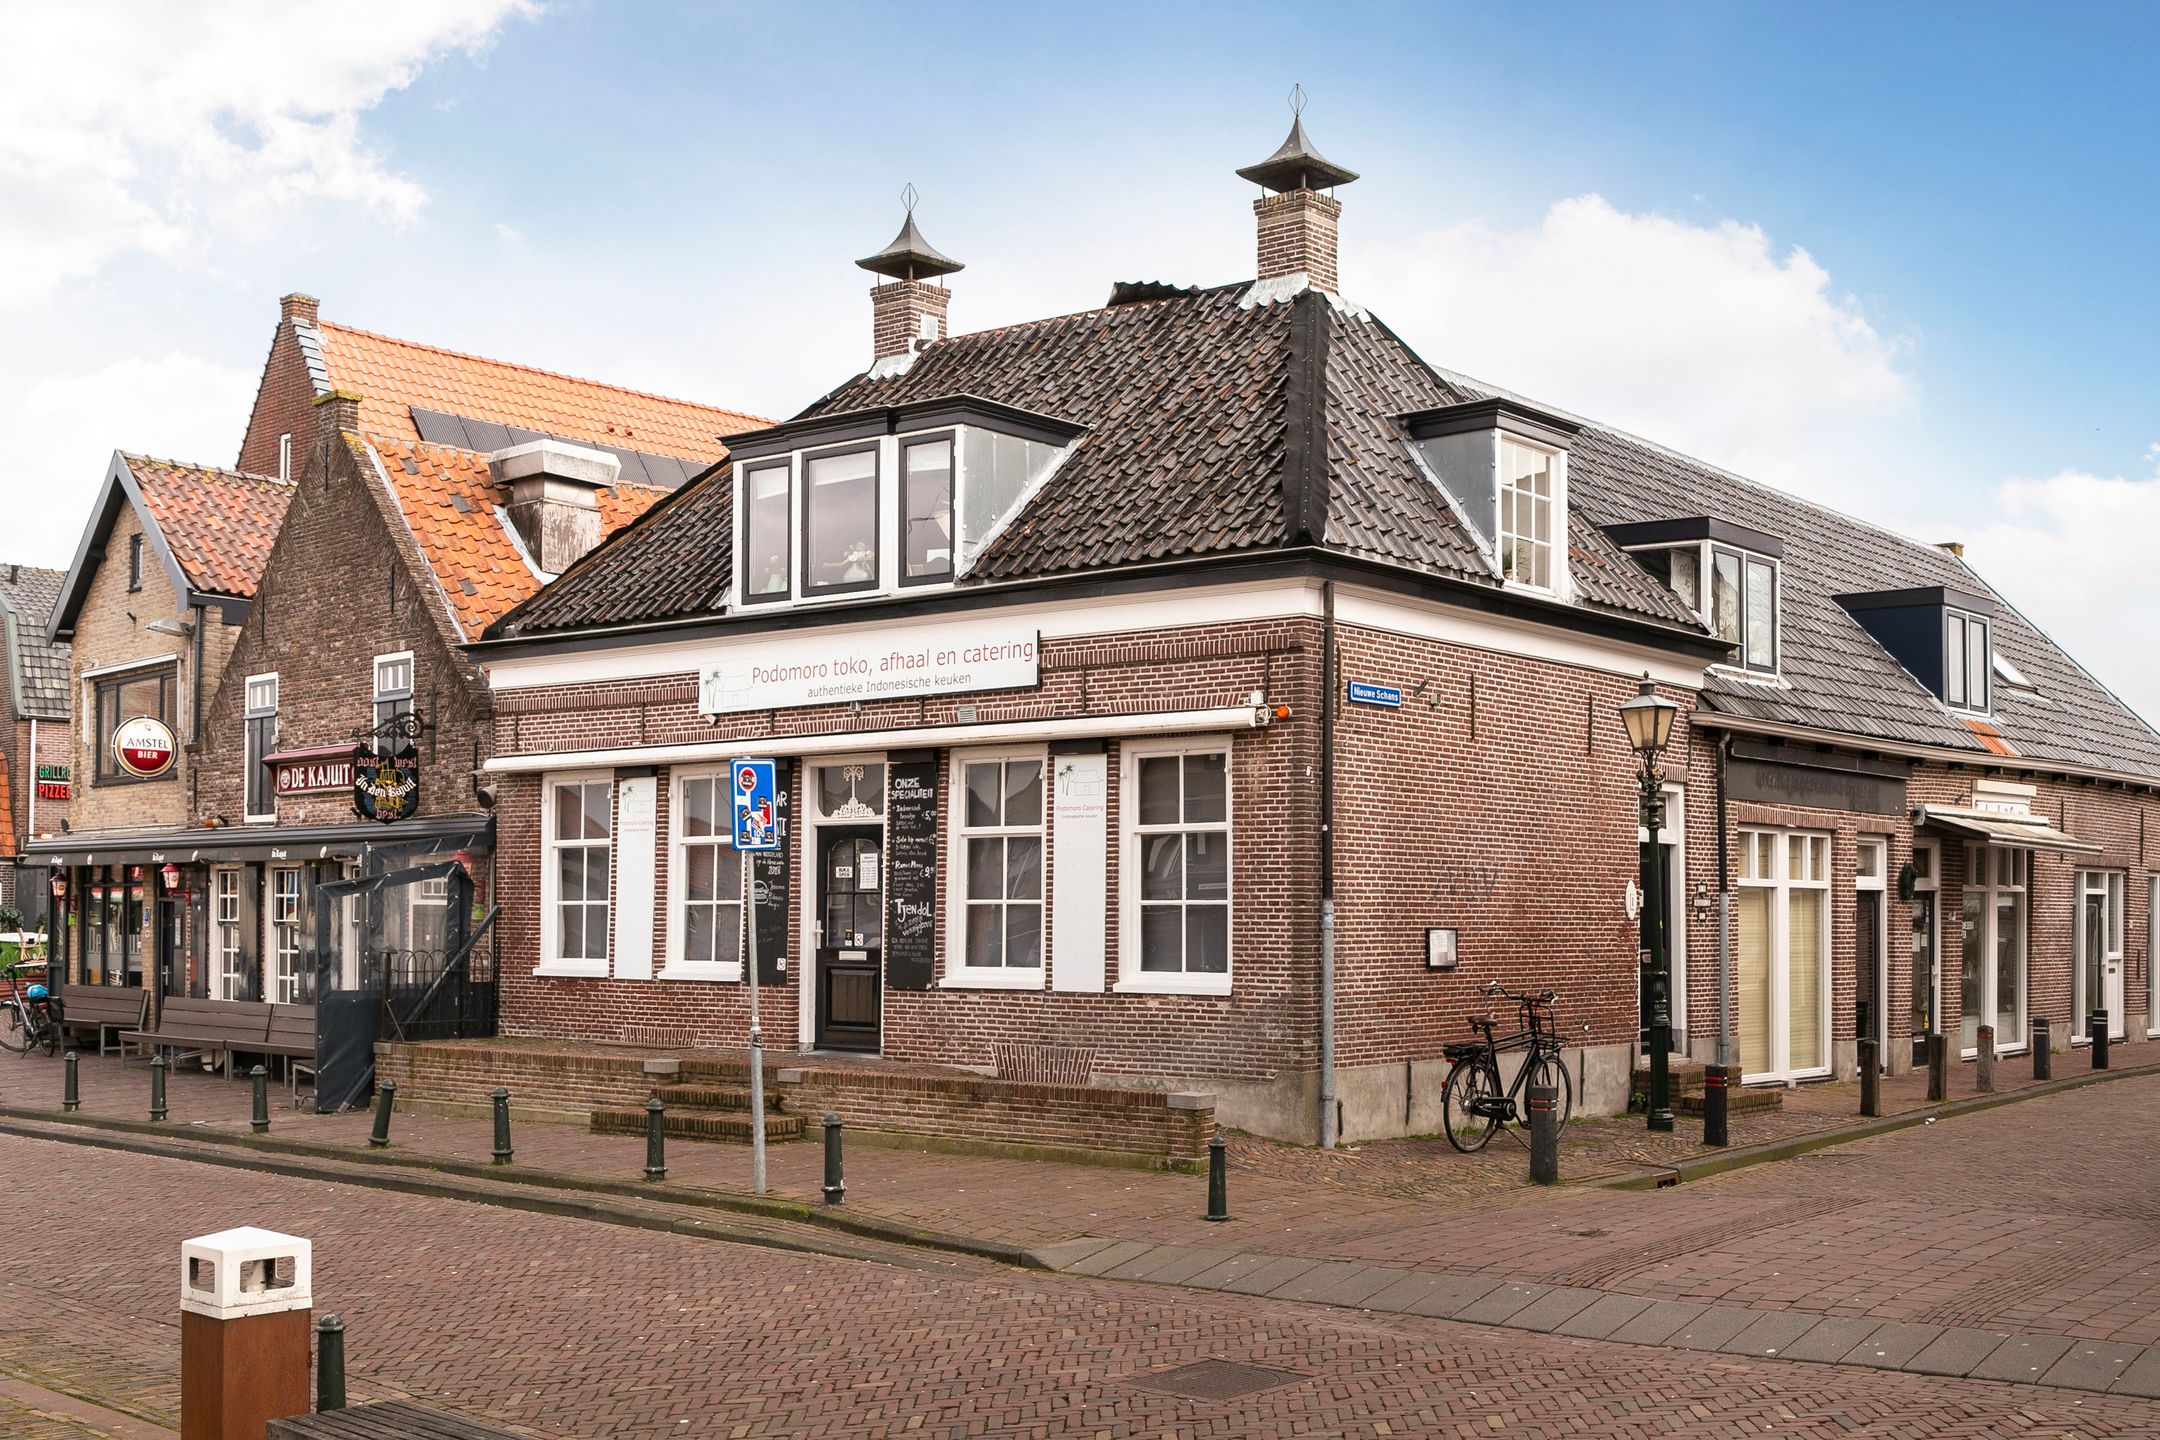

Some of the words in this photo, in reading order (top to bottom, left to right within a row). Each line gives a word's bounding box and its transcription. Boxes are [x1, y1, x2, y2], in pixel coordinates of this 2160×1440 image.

[752, 664, 828, 684] Podomoro
[833, 656, 873, 676] toko,
[880, 649, 930, 672] afhaal
[936, 649, 956, 666] en
[963, 641, 1033, 662] catering
[807, 682, 863, 698] authentieke
[866, 675, 931, 693] Indonesische
[934, 673, 972, 686] keuken
[1353, 686, 1375, 698] Nieuwe
[1376, 690, 1399, 701] Schans
[127, 738, 168, 749] AMSTEL
[137, 750, 158, 759] BIER
[291, 767, 305, 788] DE
[308, 763, 351, 787] KAJUIT
[894, 777, 920, 790] ONZE
